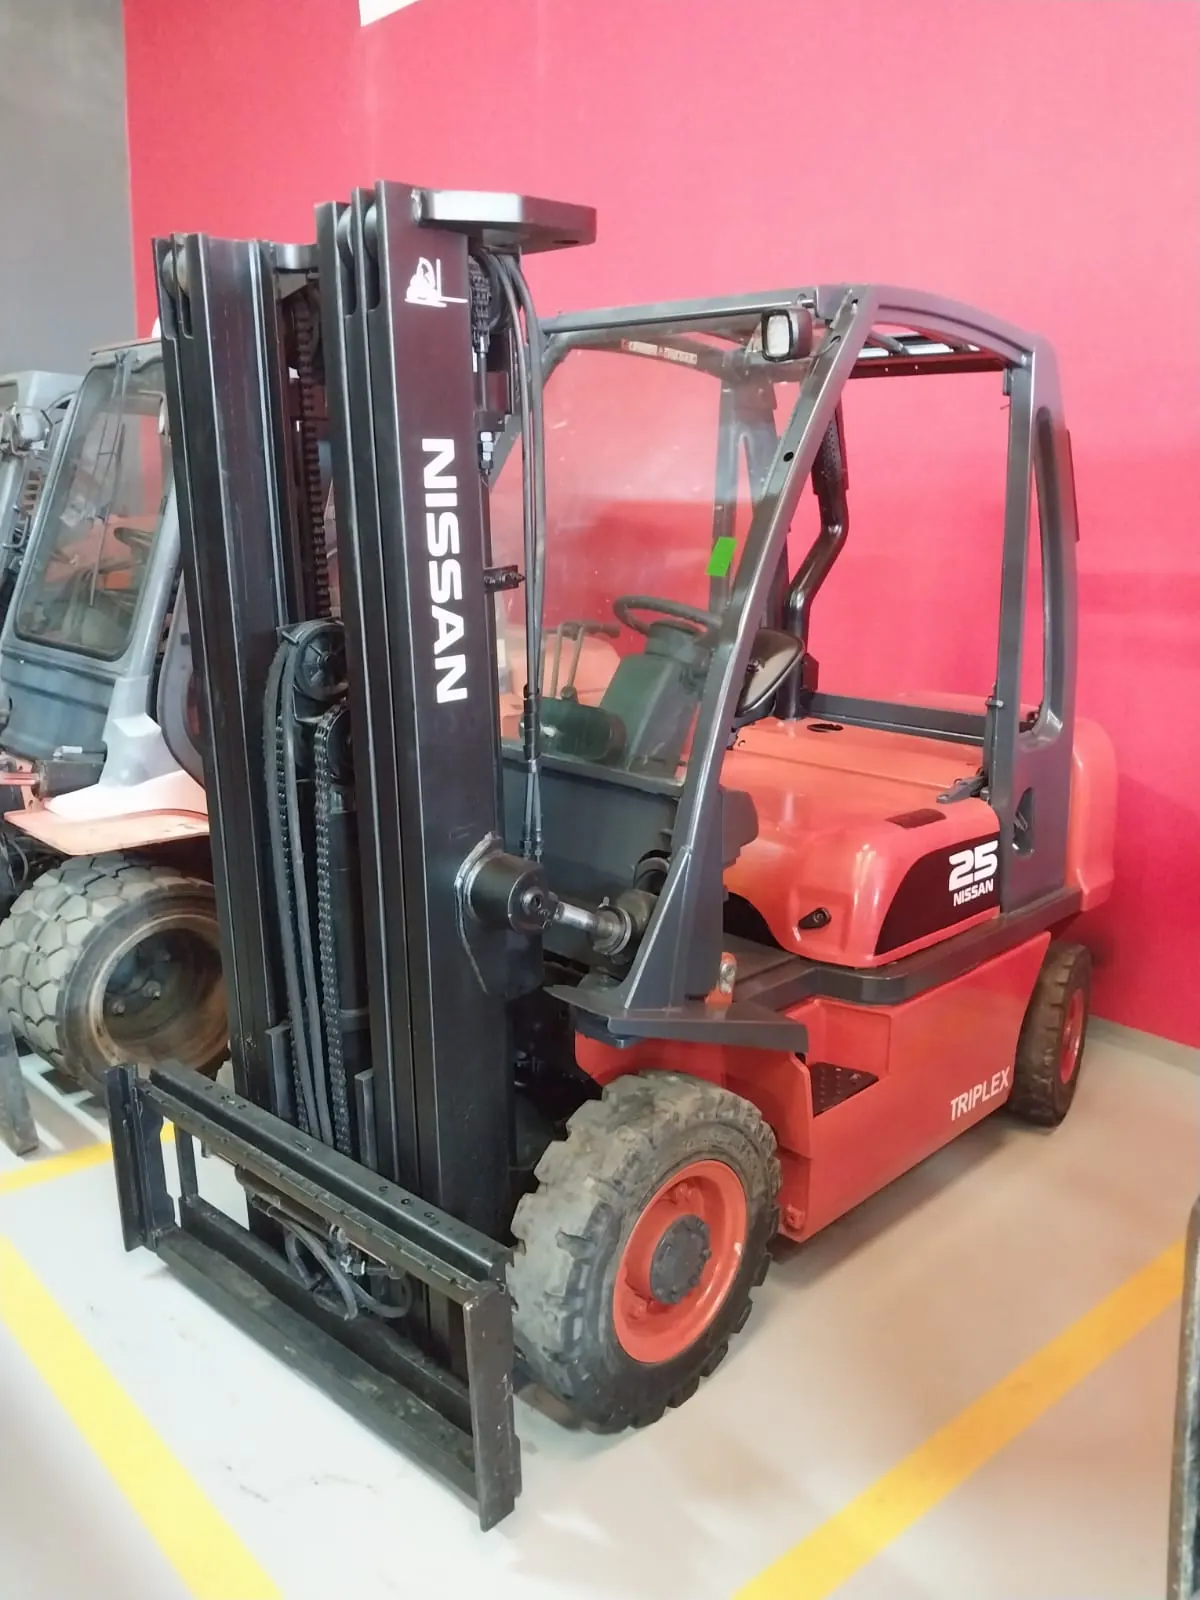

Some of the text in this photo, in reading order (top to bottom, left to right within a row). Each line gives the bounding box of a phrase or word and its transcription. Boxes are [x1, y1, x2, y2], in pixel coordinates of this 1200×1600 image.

[422, 438, 468, 704] NISSAN
[948, 840, 998, 892] 25
[953, 878, 994, 907] NISSAN
[950, 1065, 1010, 1121] TRIPLEX
